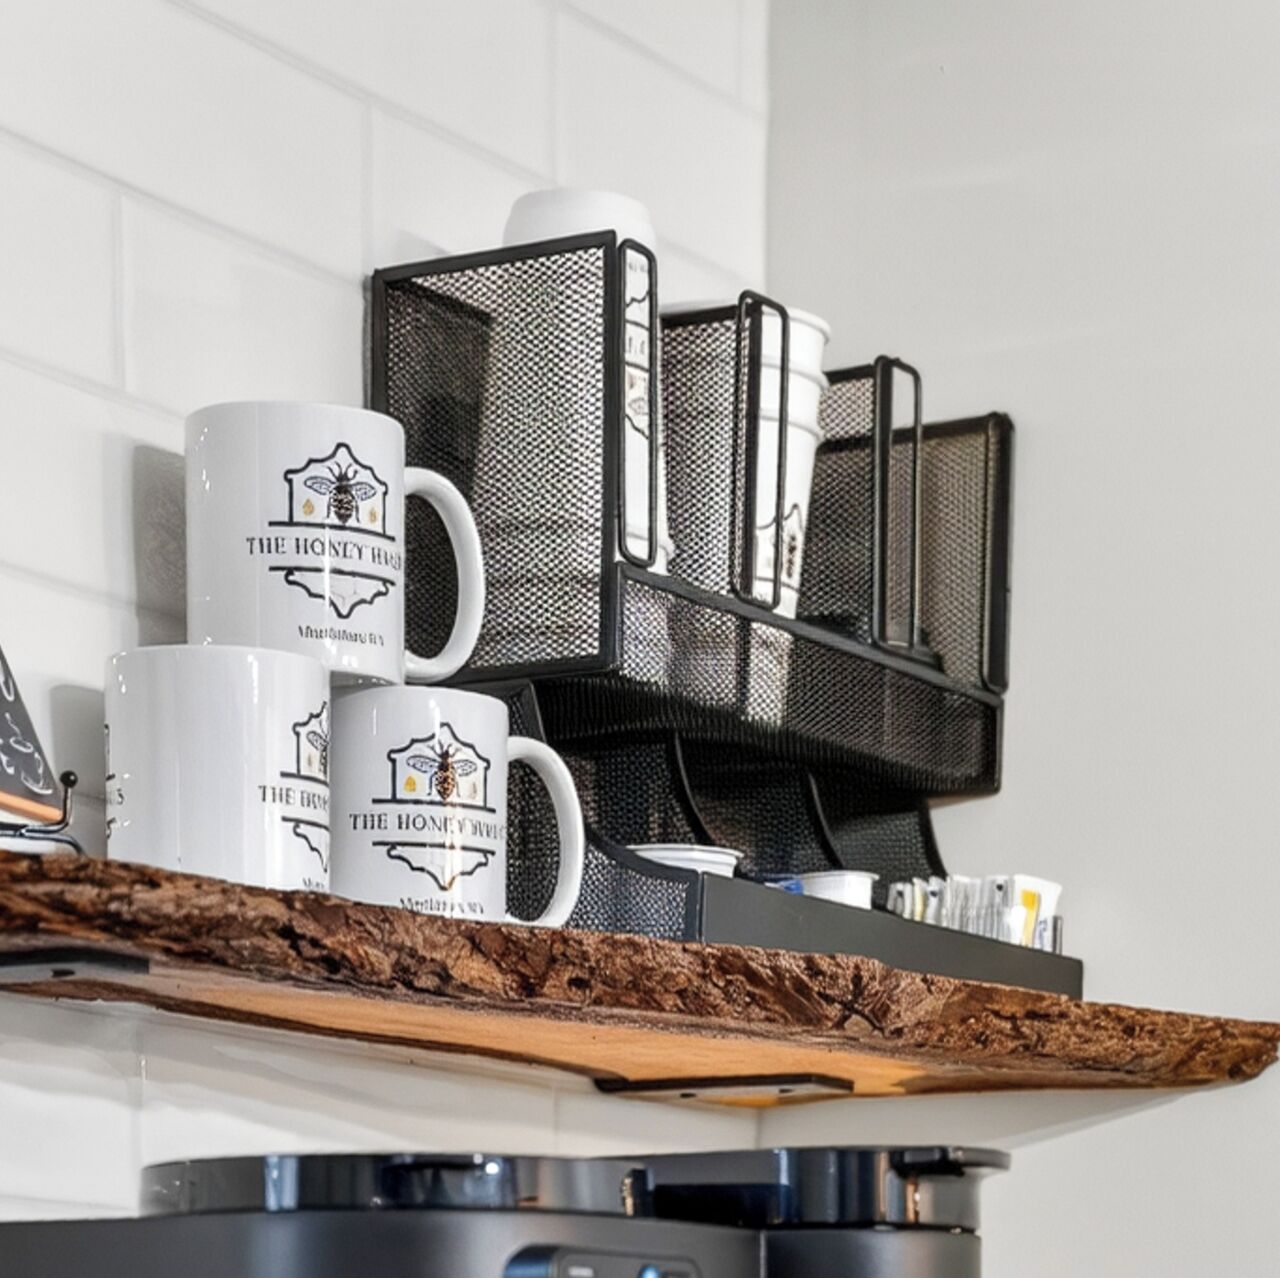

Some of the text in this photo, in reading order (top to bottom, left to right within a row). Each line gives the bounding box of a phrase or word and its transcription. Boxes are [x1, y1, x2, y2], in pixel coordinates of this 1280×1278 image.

[246, 537, 287, 555] THE
[295, 537, 365, 560] HONEY
[258, 784, 296, 805] THE
[349, 813, 388, 830] THE
